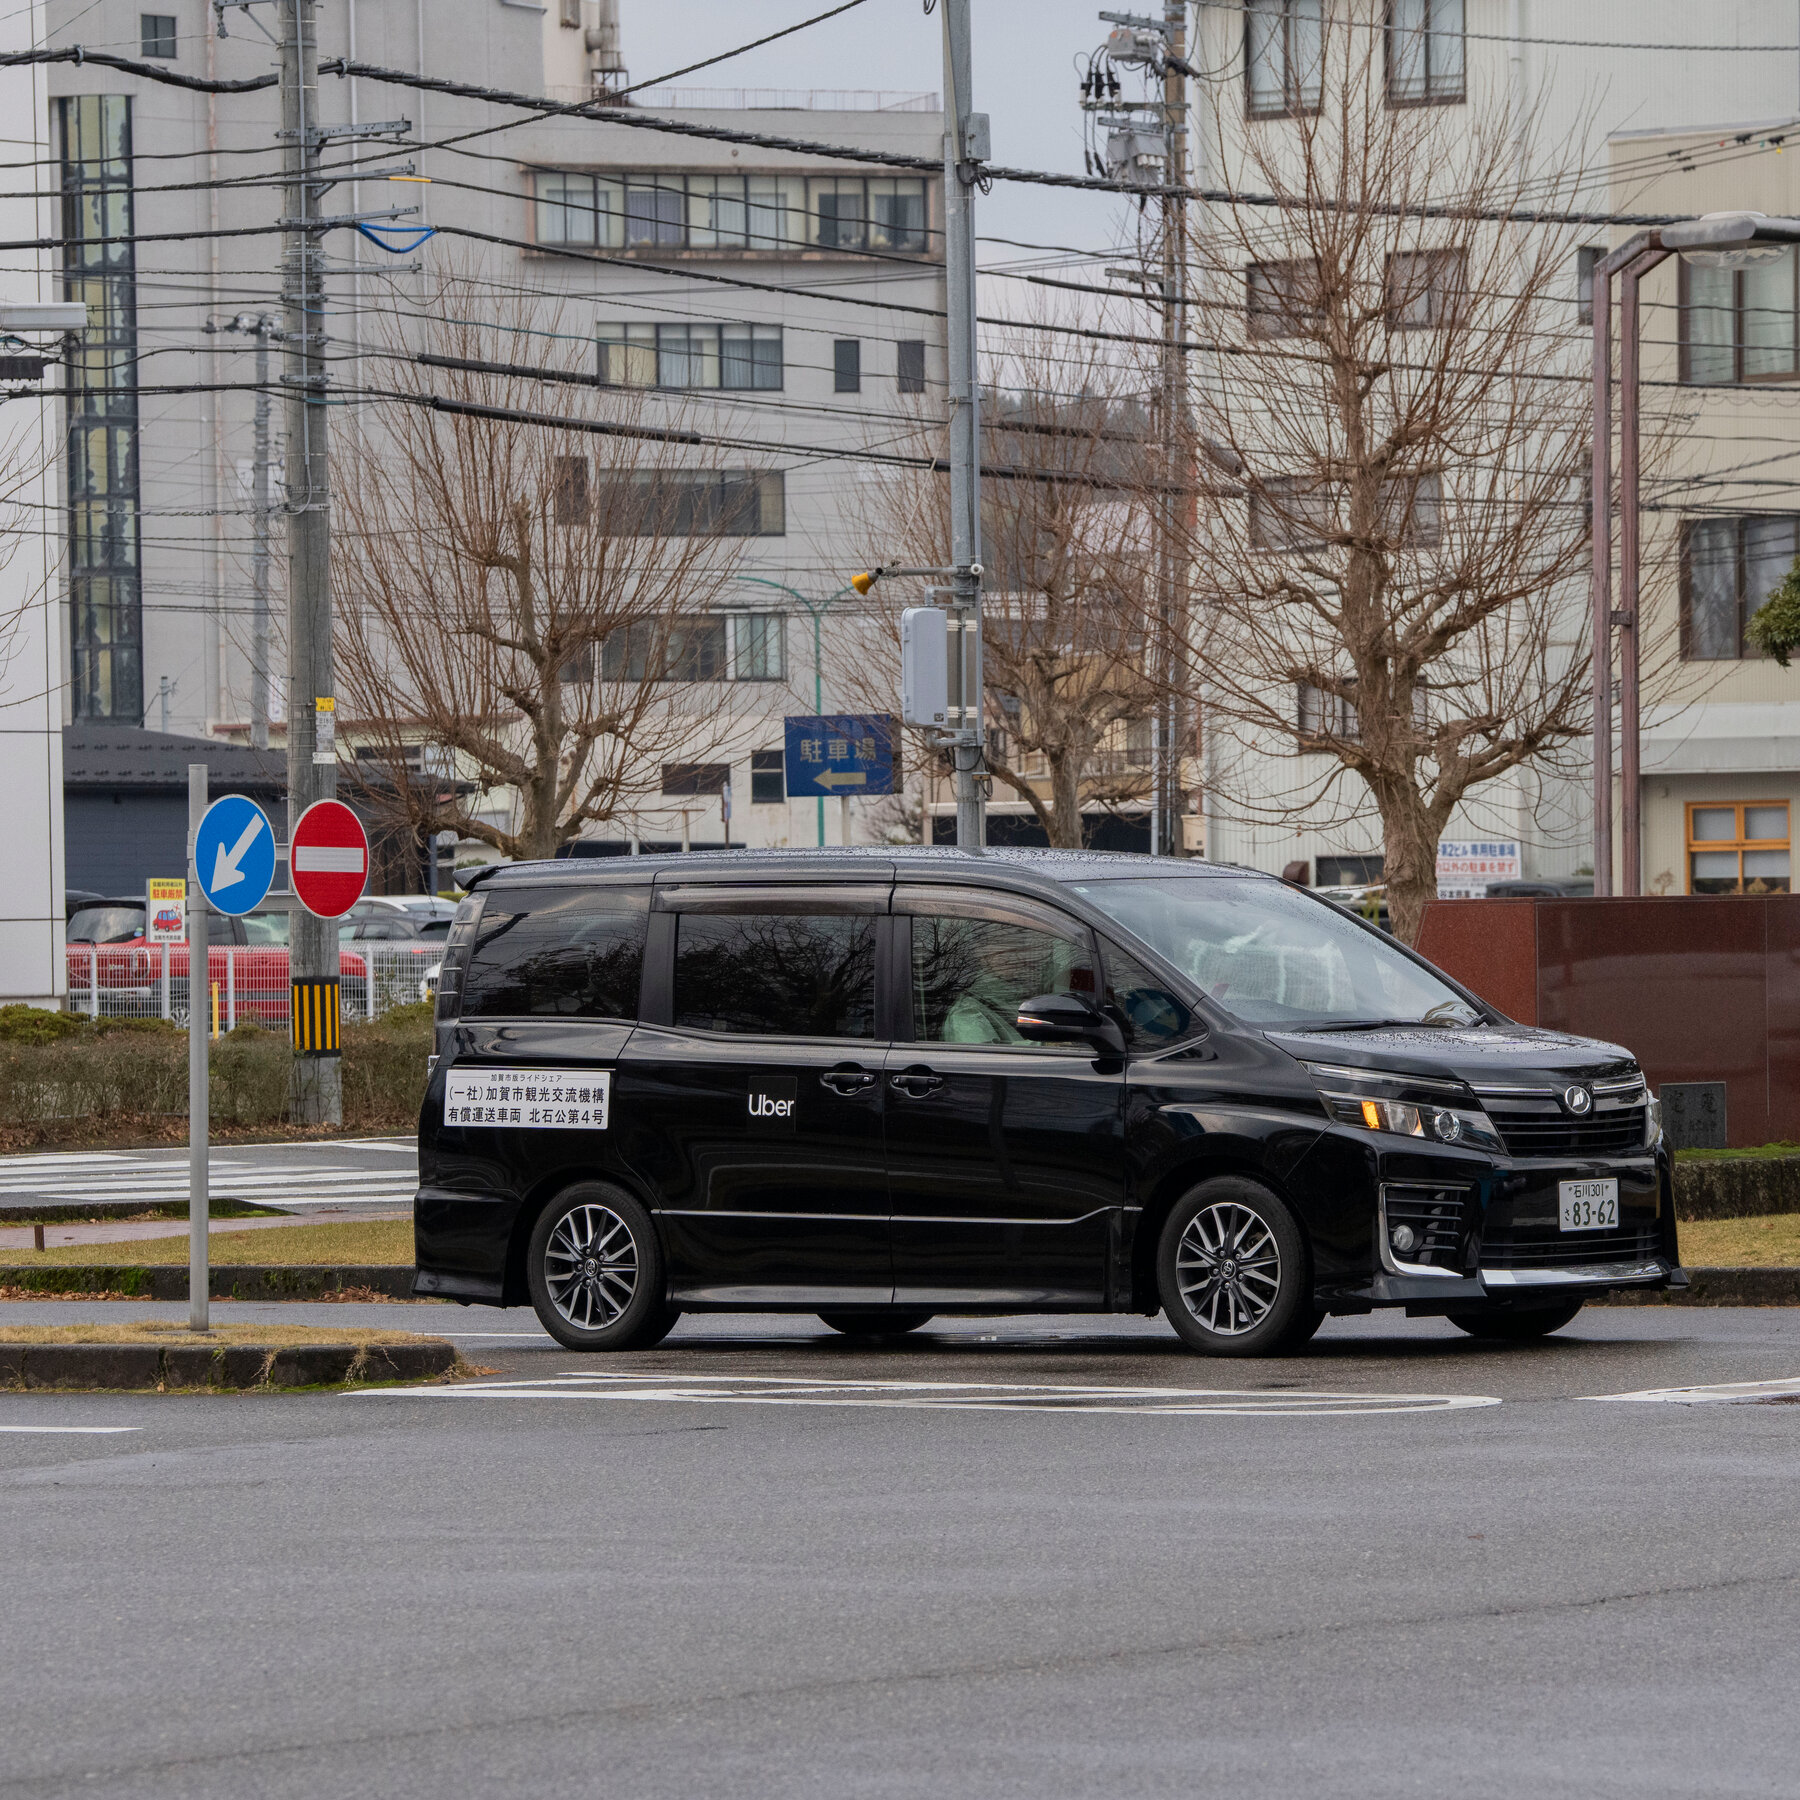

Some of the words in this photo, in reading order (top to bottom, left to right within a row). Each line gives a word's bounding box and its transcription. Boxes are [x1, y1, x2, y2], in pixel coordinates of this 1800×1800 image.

[800, 737, 877, 763] 駐車場
[1438, 843, 1468, 857] 第2ビル
[1471, 844, 1515, 857] 専用駐車場
[152, 889, 183, 899] 駐車厳禁
[491, 1073, 562, 1082] 加賀市版ライドシェア
[449, 1085, 604, 1104] (一社)加賀市観光交流機構
[748, 1094, 795, 1117] Uber
[448, 1106, 521, 1123] 有償運送車両
[528, 1108, 604, 1125] 北石公第4号
[1573, 1199, 1616, 1226] 83-62
